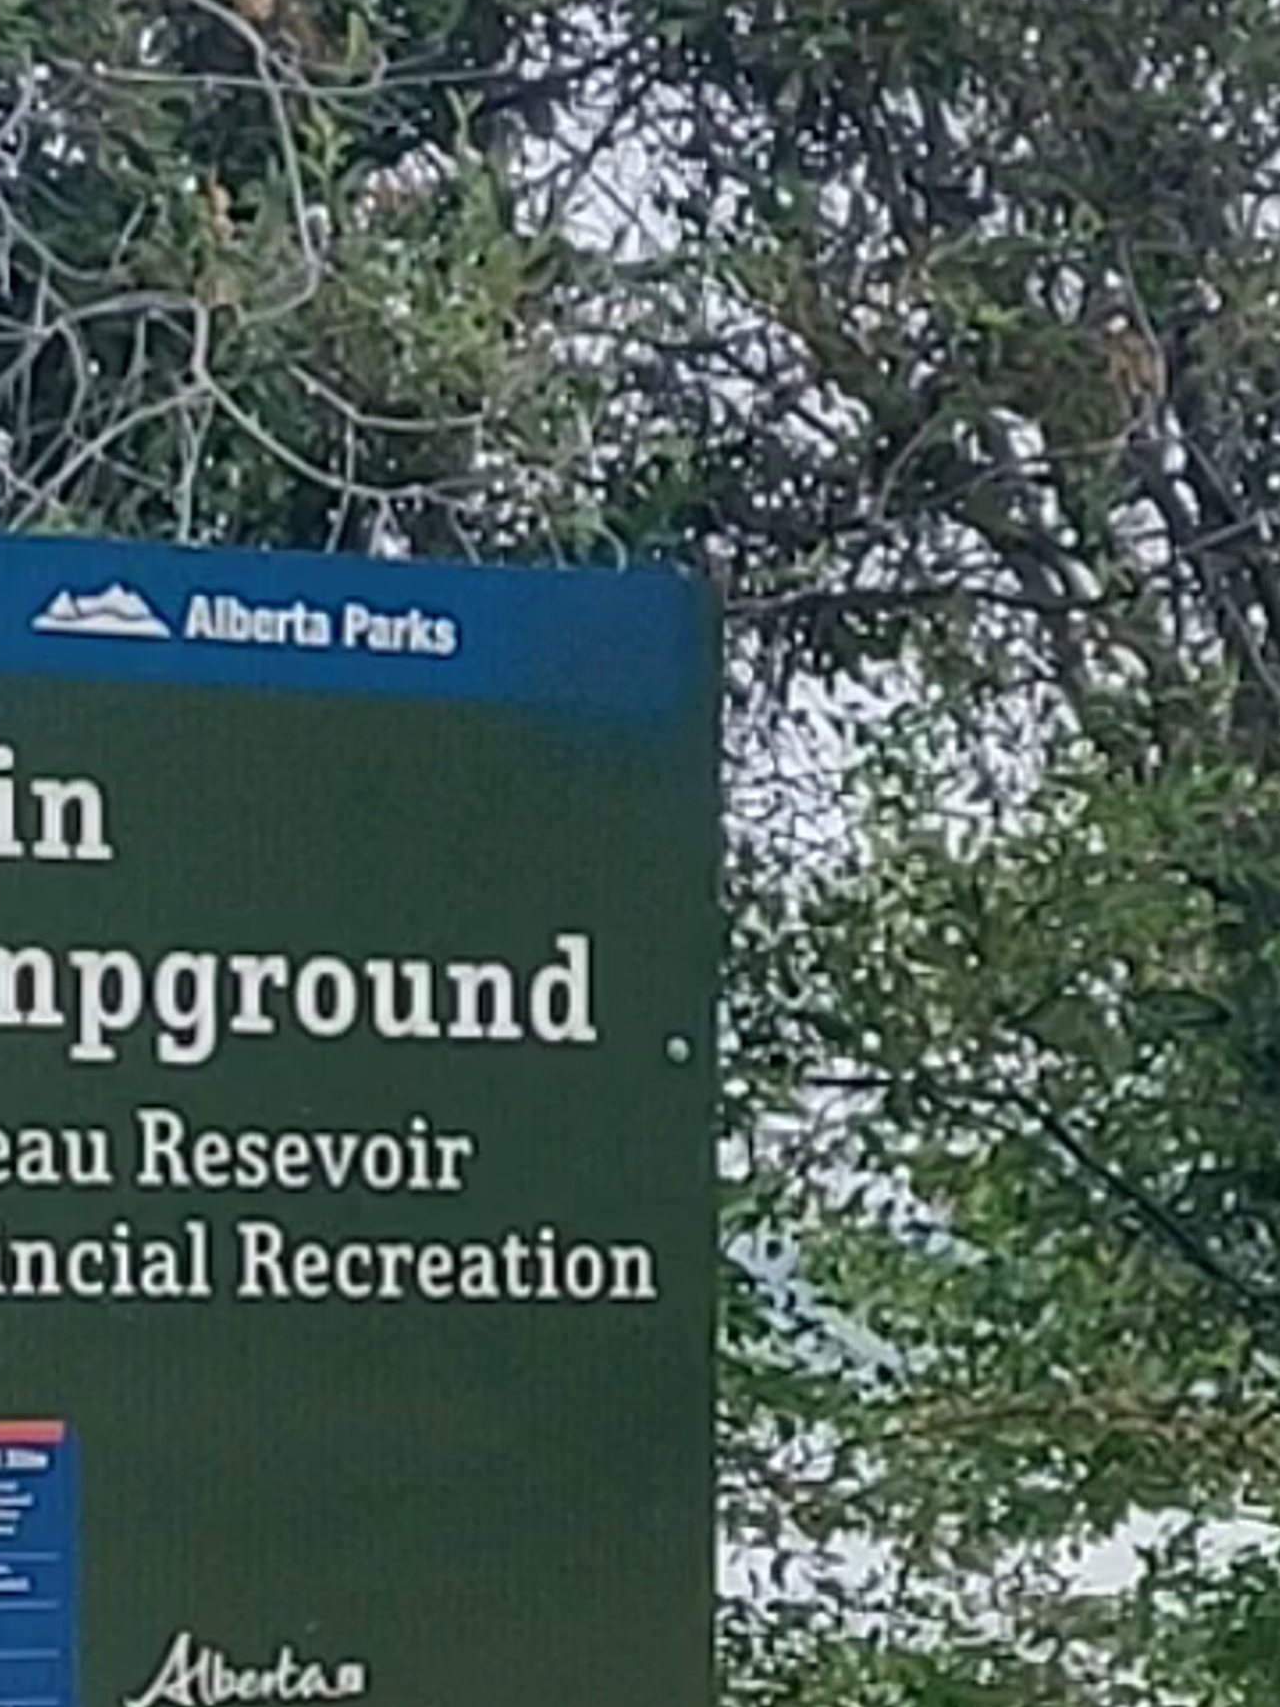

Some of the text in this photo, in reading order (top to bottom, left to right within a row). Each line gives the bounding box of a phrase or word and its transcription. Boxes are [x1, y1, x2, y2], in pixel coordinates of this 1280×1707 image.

[185, 595, 455, 654] Alberta Parks
[138, 1109, 471, 1189] Resevoir
[238, 1222, 656, 1298] Recreation
